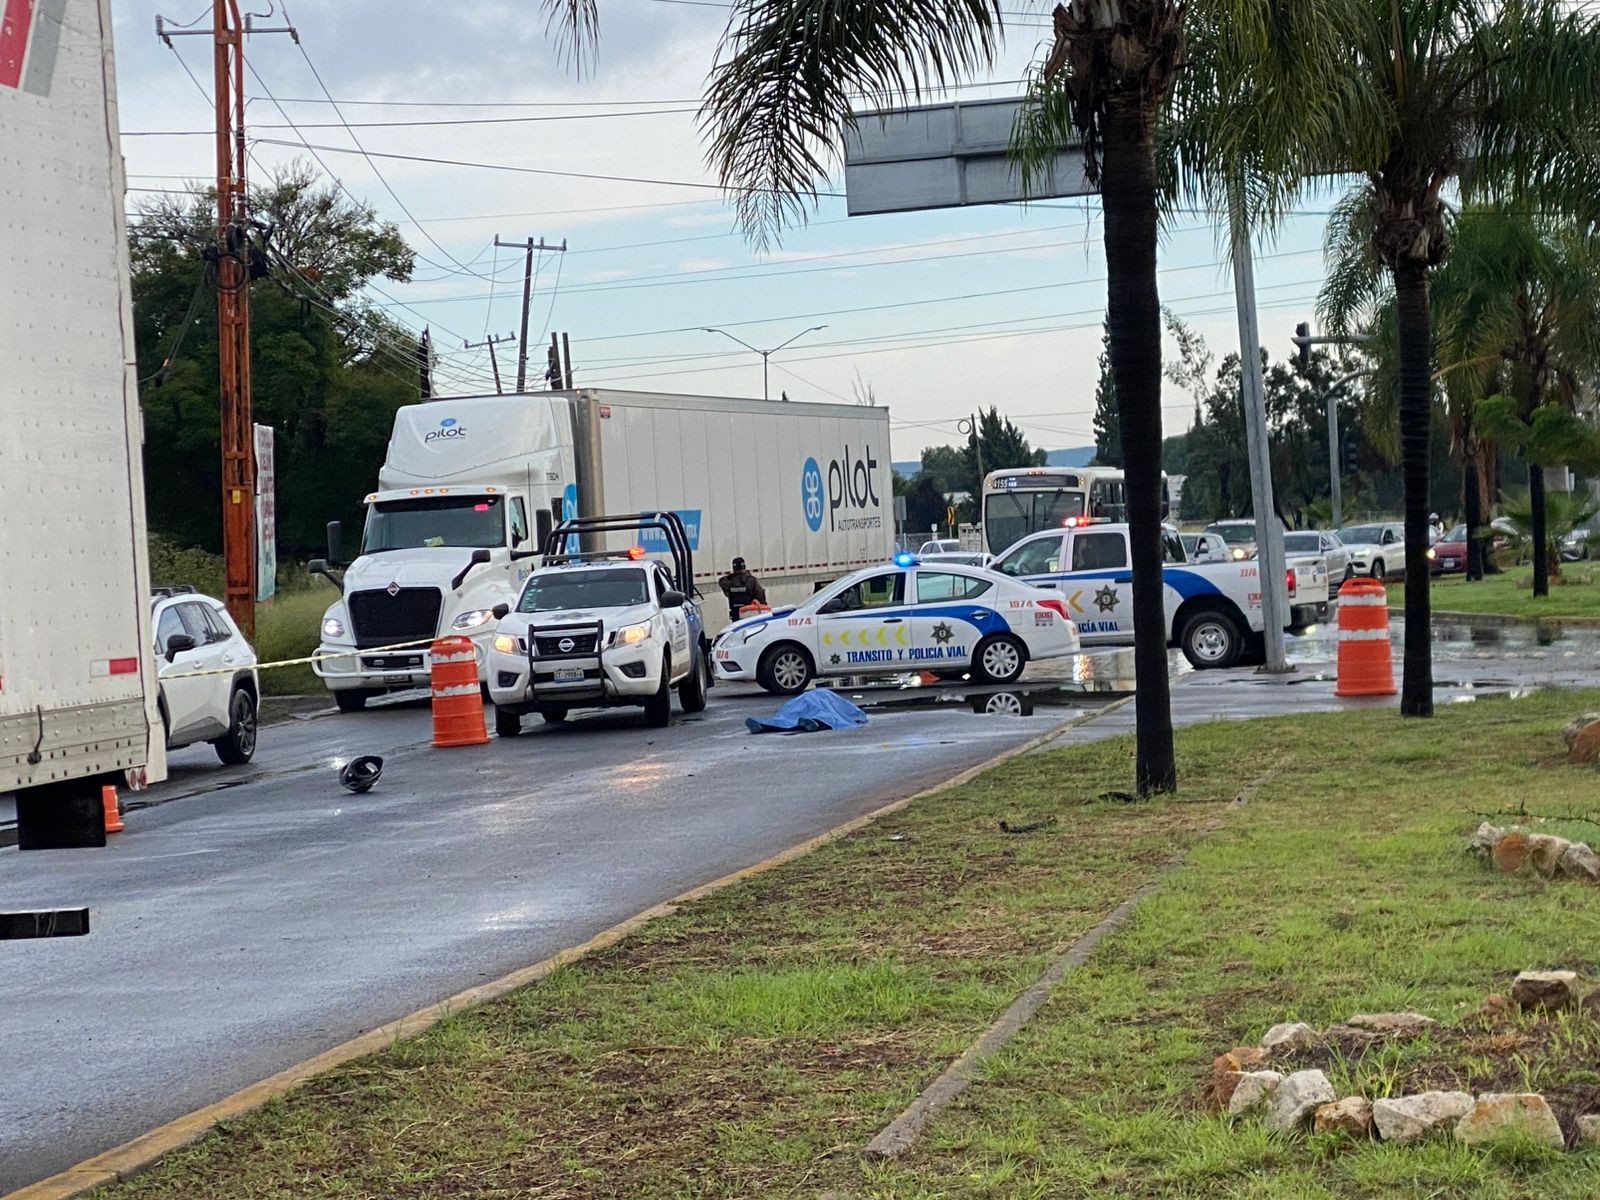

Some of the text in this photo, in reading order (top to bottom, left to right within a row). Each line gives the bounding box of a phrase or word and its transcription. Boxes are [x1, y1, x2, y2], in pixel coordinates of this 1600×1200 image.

[424, 426, 467, 444] pilot
[828, 444, 879, 532] pilot
[992, 479, 1008, 489] 4155
[838, 516, 881, 531] AUTOTRANSPORTES
[1009, 599, 1034, 609] 1974
[787, 617, 812, 627] 1974
[1099, 620, 1120, 633] VIAL
[846, 645, 967, 663] TRANSITO Y POLICIA VIAL
